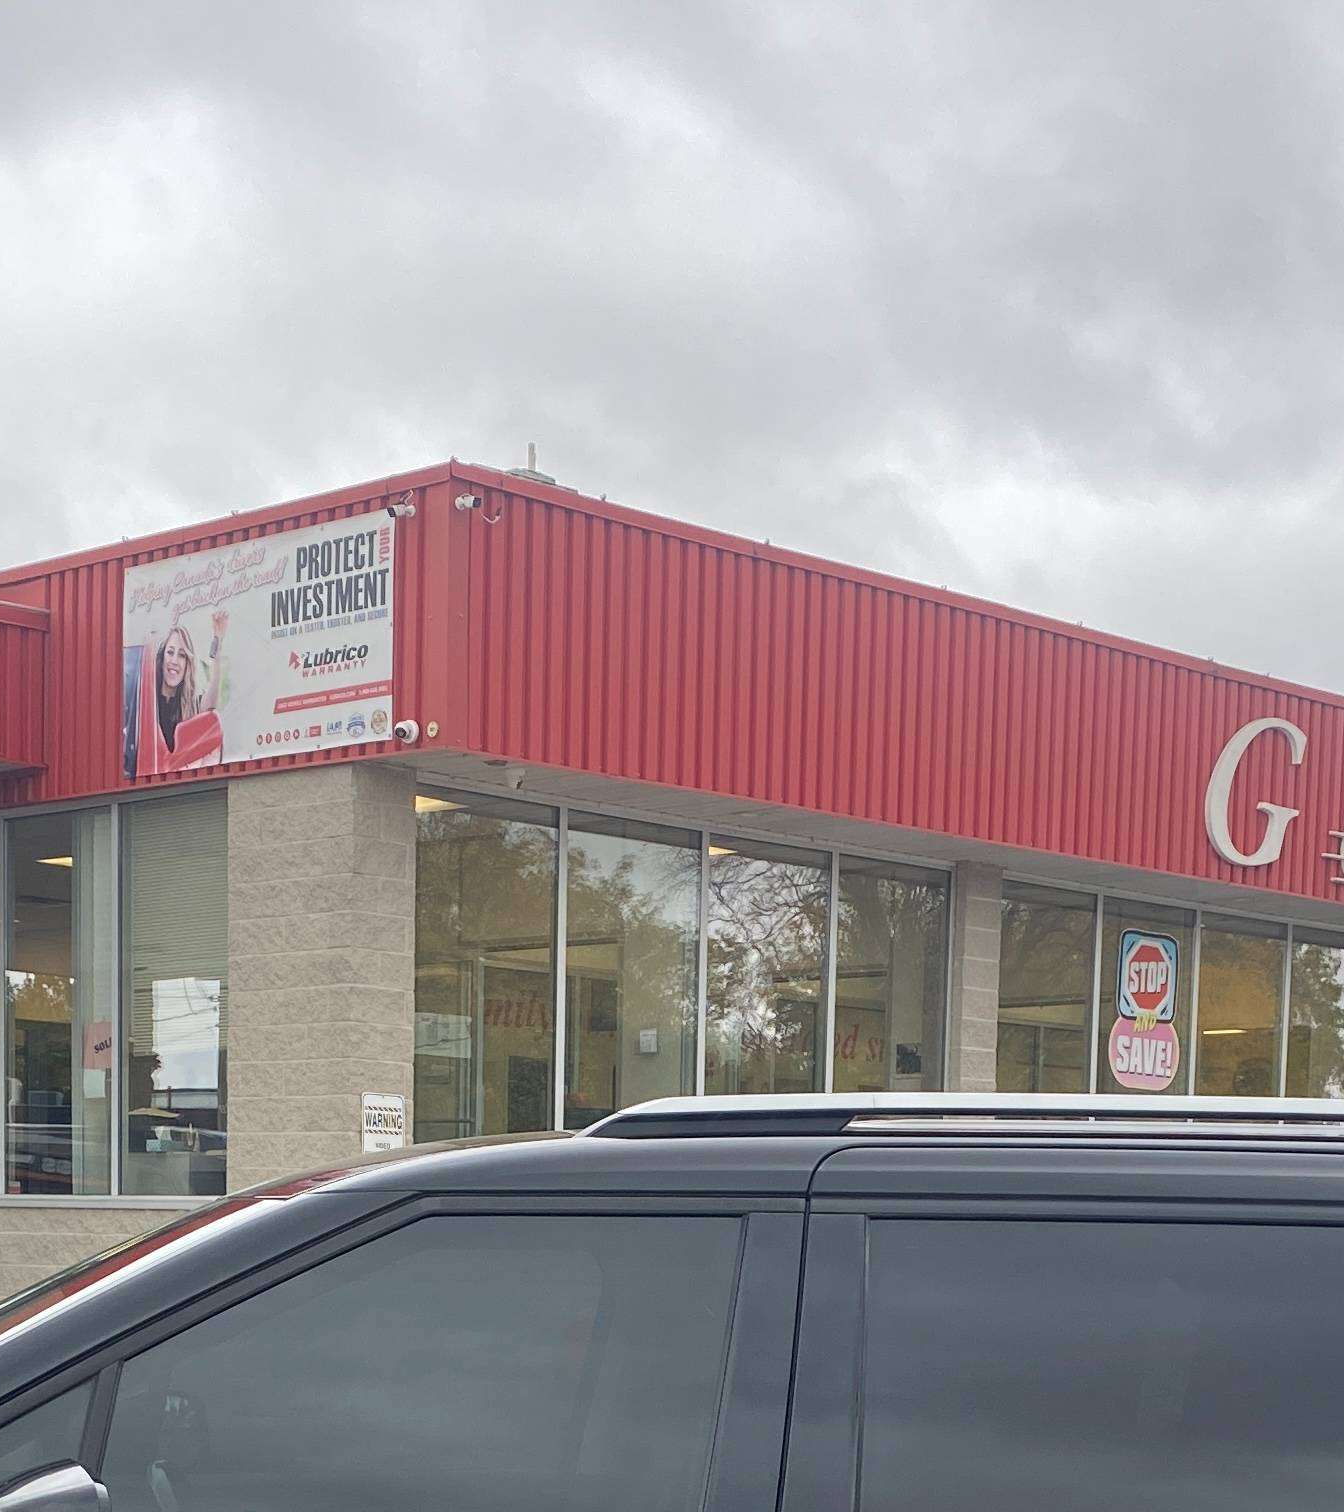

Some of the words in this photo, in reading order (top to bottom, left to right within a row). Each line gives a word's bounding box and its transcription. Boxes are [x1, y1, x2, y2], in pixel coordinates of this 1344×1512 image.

[296, 530, 377, 583] PROTECT
[379, 527, 390, 564] YOUR
[272, 568, 389, 627] INVESTMENT
[302, 660, 367, 678] WARRANTY
[303, 644, 368, 669] Lubrico
[1129, 960, 1168, 994] STOP
[1134, 1012, 1157, 1033] AND
[1116, 1035, 1173, 1079] SAVE!
[365, 1112, 403, 1129] WARNING
